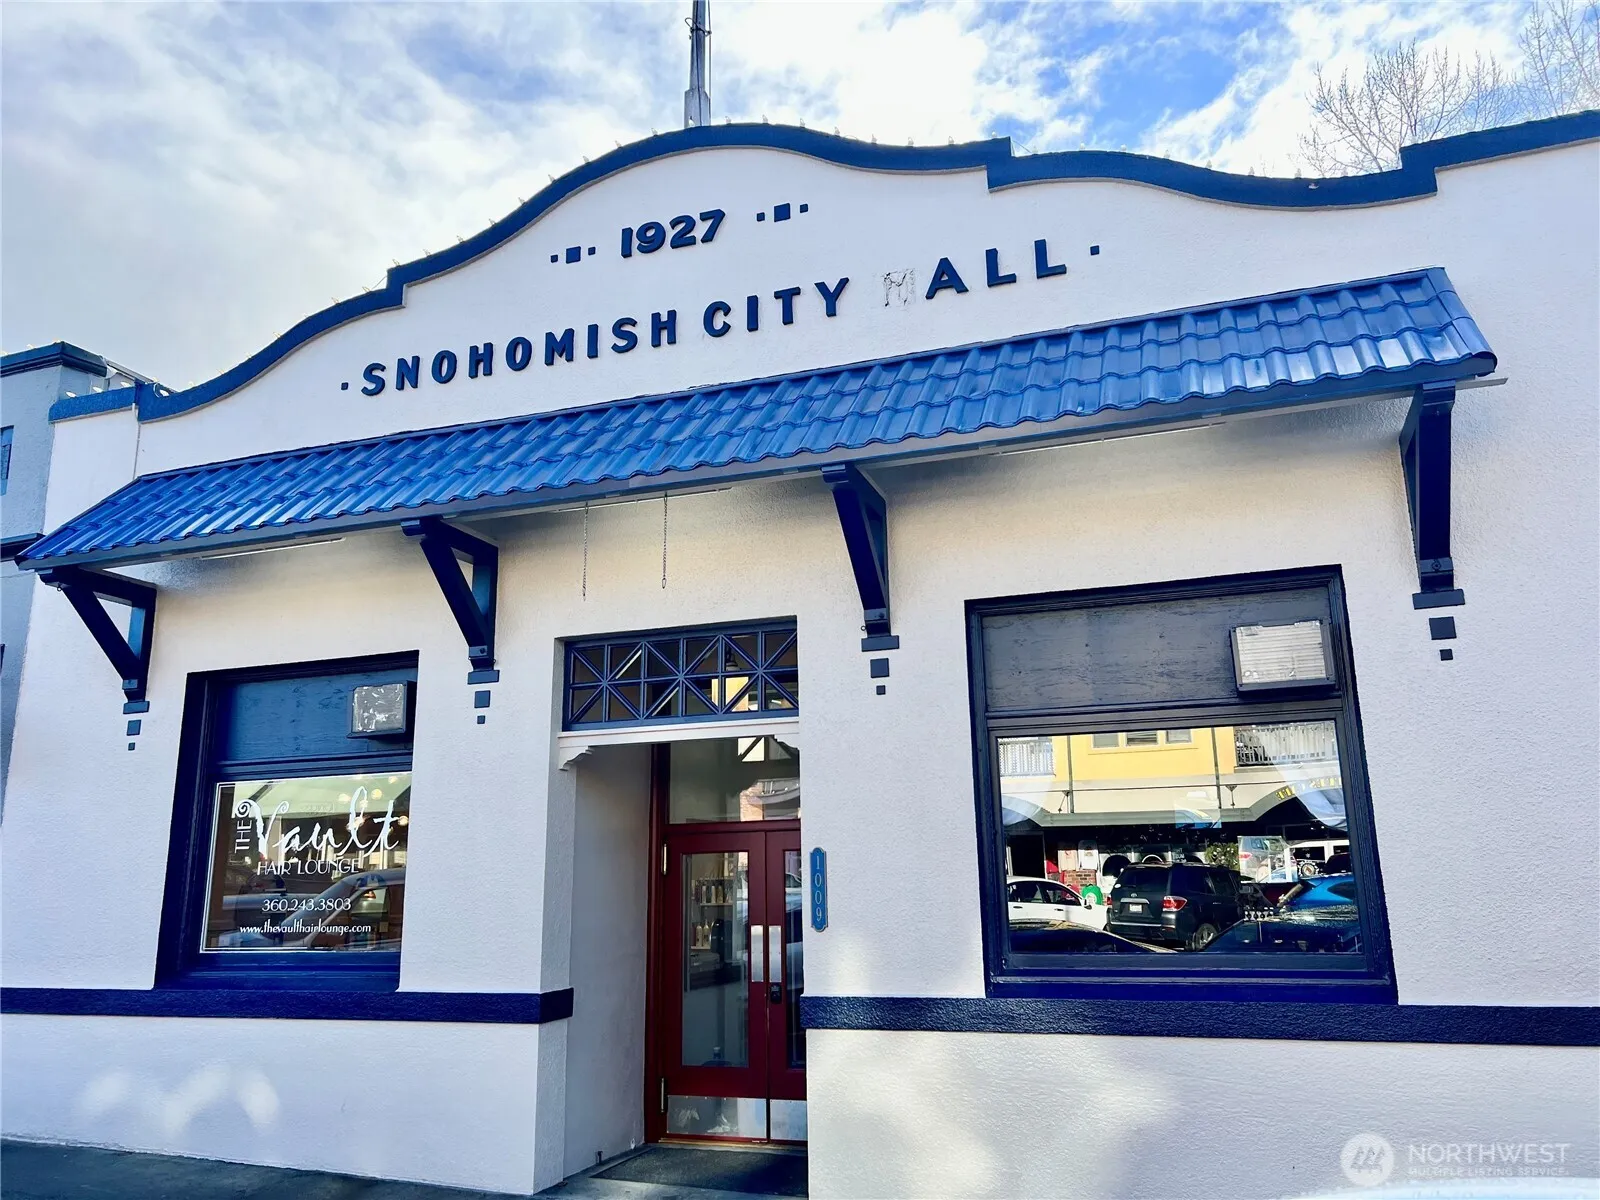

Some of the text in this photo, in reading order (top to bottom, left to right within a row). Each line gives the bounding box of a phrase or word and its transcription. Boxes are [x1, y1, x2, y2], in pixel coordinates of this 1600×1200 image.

[620, 209, 726, 258] 1927
[360, 307, 678, 397] SNOHOMISH
[703, 276, 850, 338] CITY
[234, 819, 252, 853] THE
[235, 785, 400, 862] Vault
[256, 857, 360, 876] HAIR LOUNGE
[261, 897, 352, 913] 360.243.3803
[814, 855, 822, 922] 1009
[239, 918, 372, 937] www.thevaulthairlounge.com
